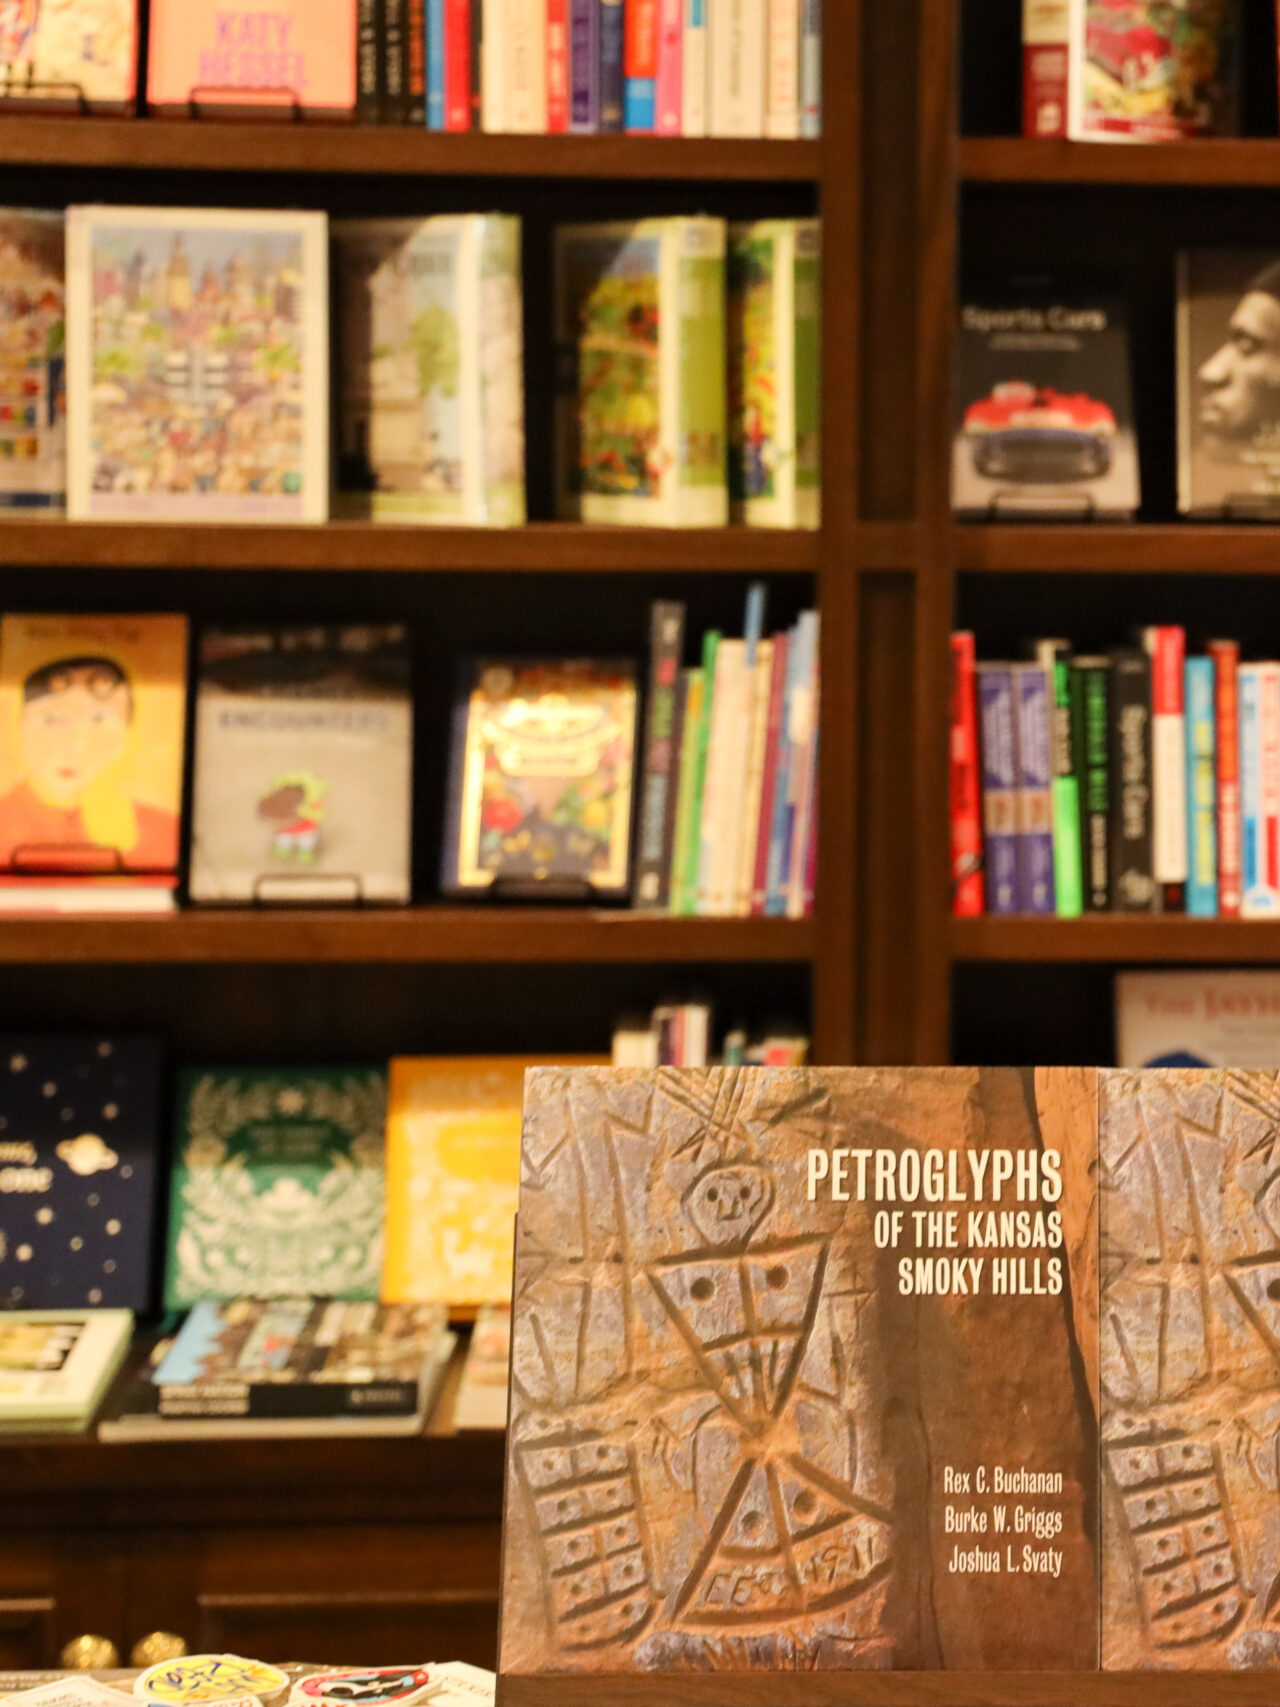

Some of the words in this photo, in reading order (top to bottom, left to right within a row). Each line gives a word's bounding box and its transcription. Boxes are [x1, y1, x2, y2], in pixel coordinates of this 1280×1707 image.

[806, 1148, 1063, 1203] PETROGLYPHS
[874, 1210, 904, 1249] OF
[912, 1211, 959, 1248] THE
[967, 1211, 1063, 1249] KANSAS
[898, 1257, 984, 1296] SMOKY
[992, 1257, 1063, 1296] HILLS
[944, 1465, 970, 1494] Rex
[976, 1465, 990, 1494] C.
[994, 1465, 1063, 1494] Buchanan
[945, 1505, 987, 1533] Burke
[993, 1505, 1011, 1533] W.
[1014, 1505, 1063, 1539] Griggs
[949, 1544, 1000, 1573] Joshua
[1007, 1545, 1020, 1573] L.
[1022, 1544, 1063, 1578] Svaty
